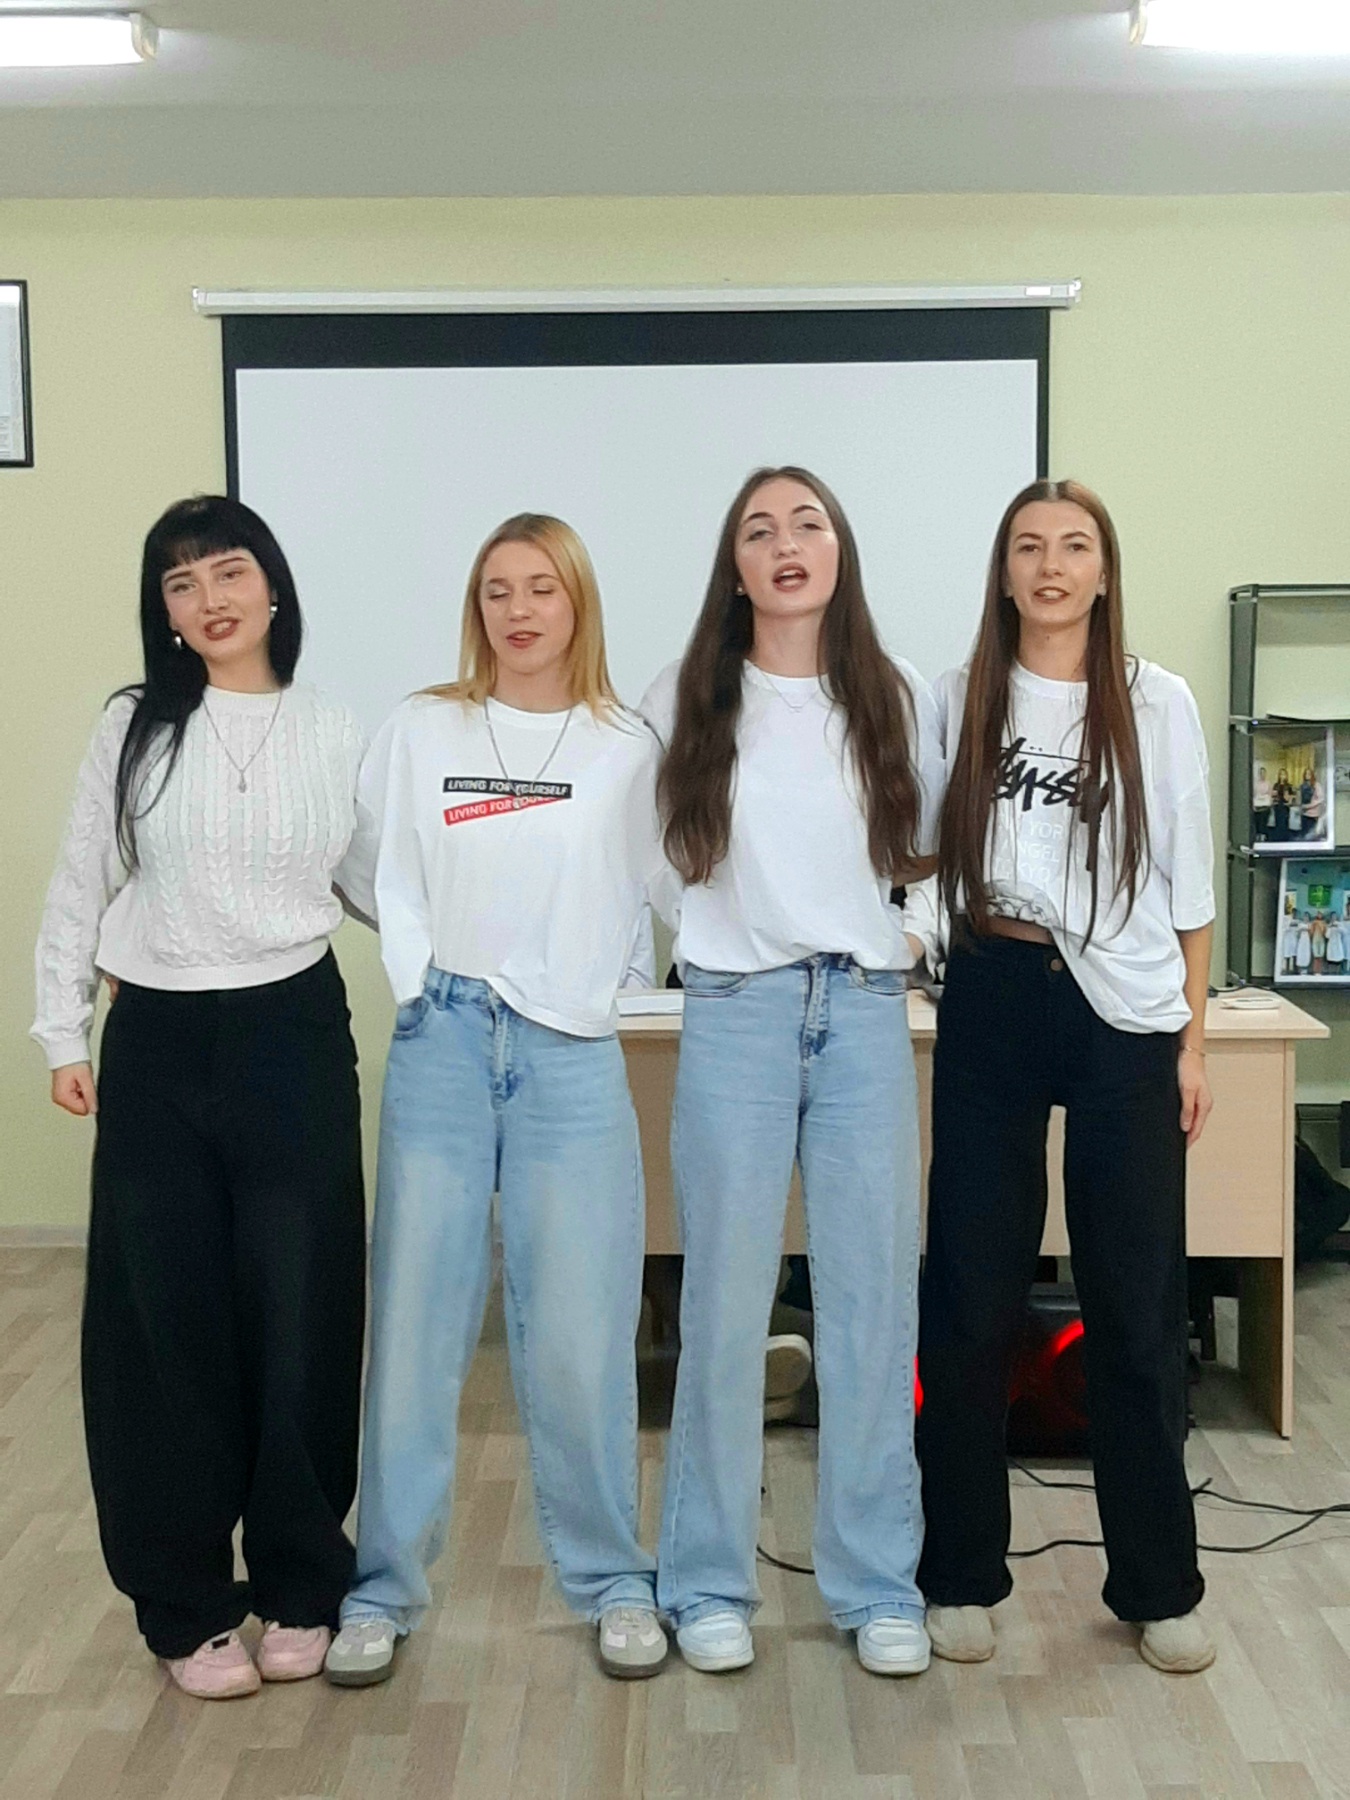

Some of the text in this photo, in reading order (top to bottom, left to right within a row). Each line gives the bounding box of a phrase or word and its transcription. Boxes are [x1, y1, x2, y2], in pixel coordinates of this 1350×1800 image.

[447, 779, 487, 791] LIVING
[489, 781, 511, 792] FOR
[448, 804, 487, 821] LIVING
[489, 799, 512, 812] FOR
